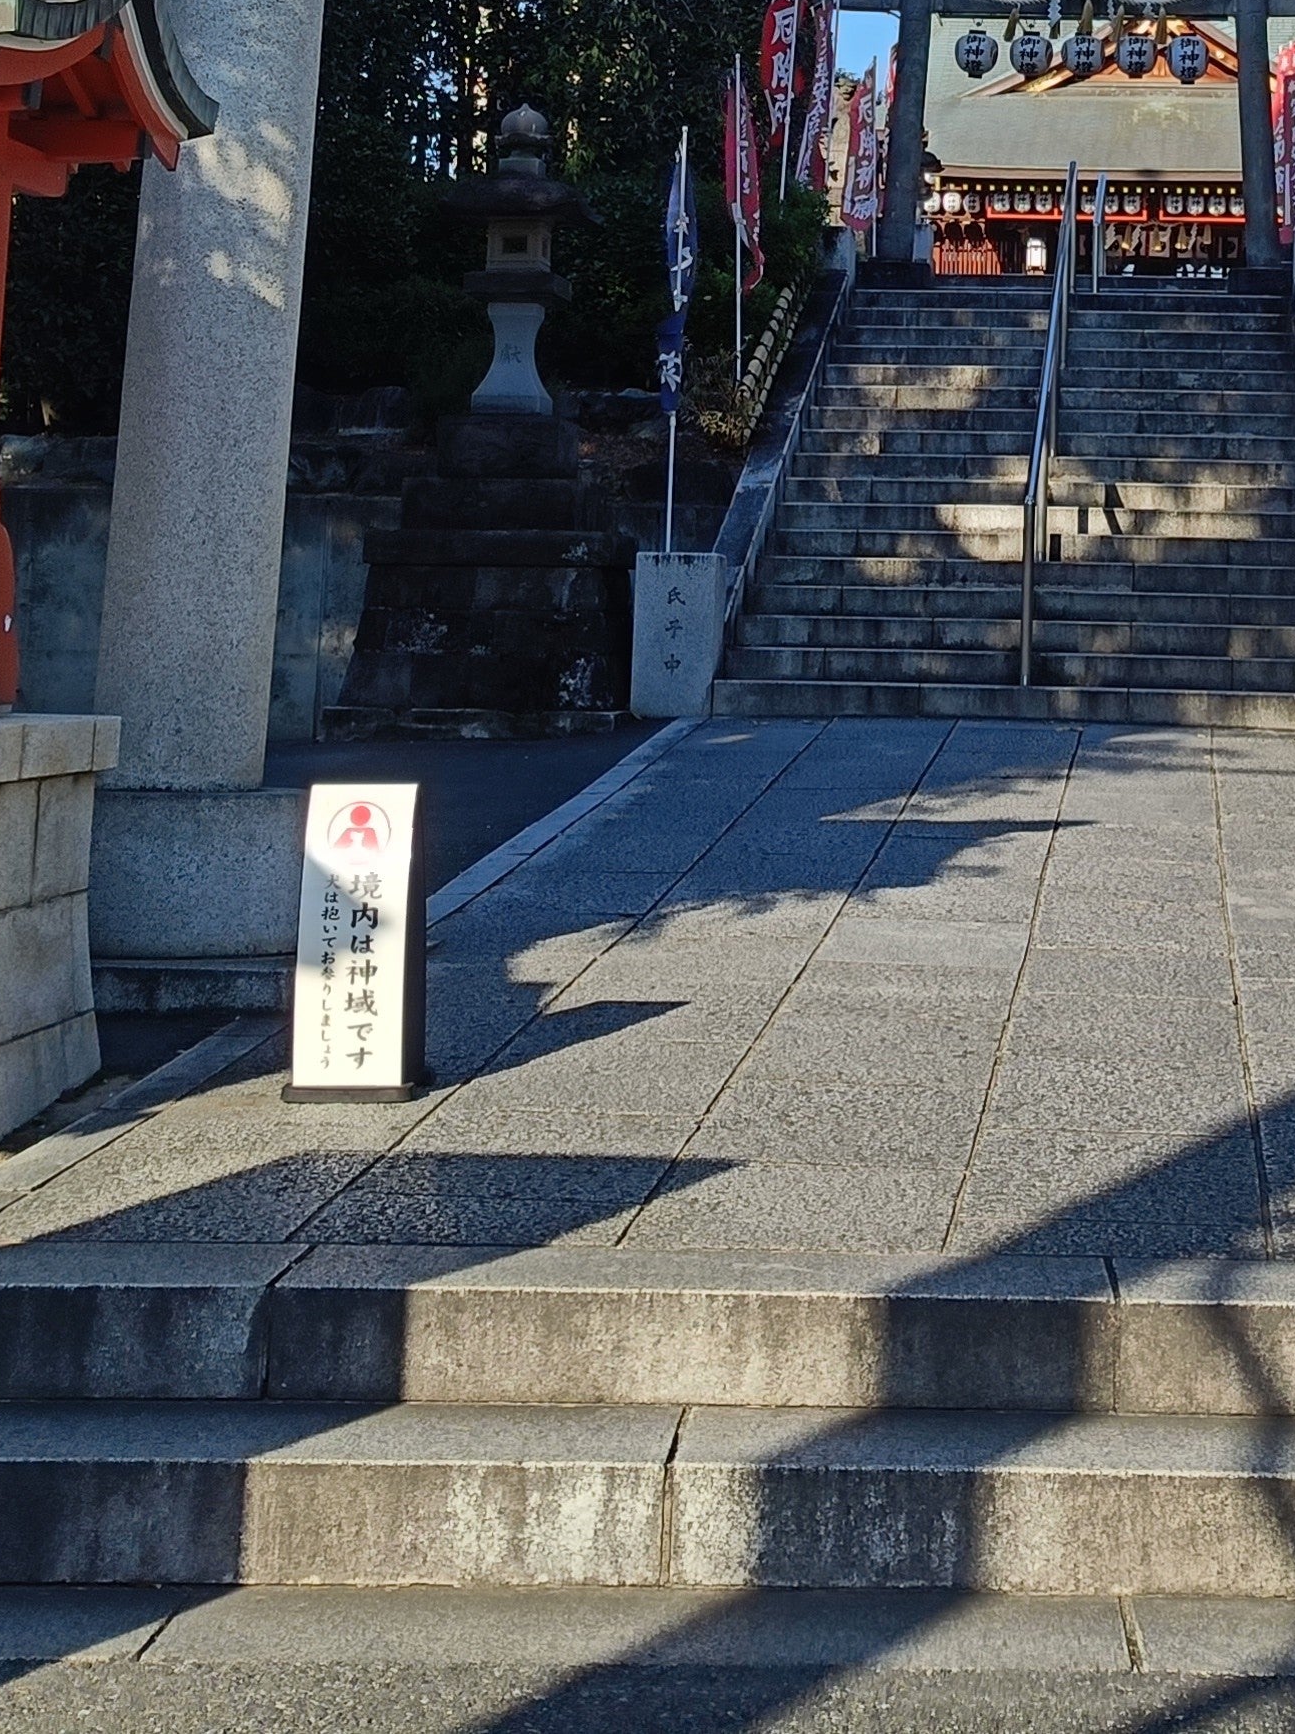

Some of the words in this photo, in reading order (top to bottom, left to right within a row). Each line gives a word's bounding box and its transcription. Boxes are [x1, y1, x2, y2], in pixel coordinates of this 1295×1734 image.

[663, 585, 686, 678] 氏子中
[320, 873, 341, 1069] 犬は抱いてお参りしましょう
[344, 871, 382, 1069] 境内は神域です
